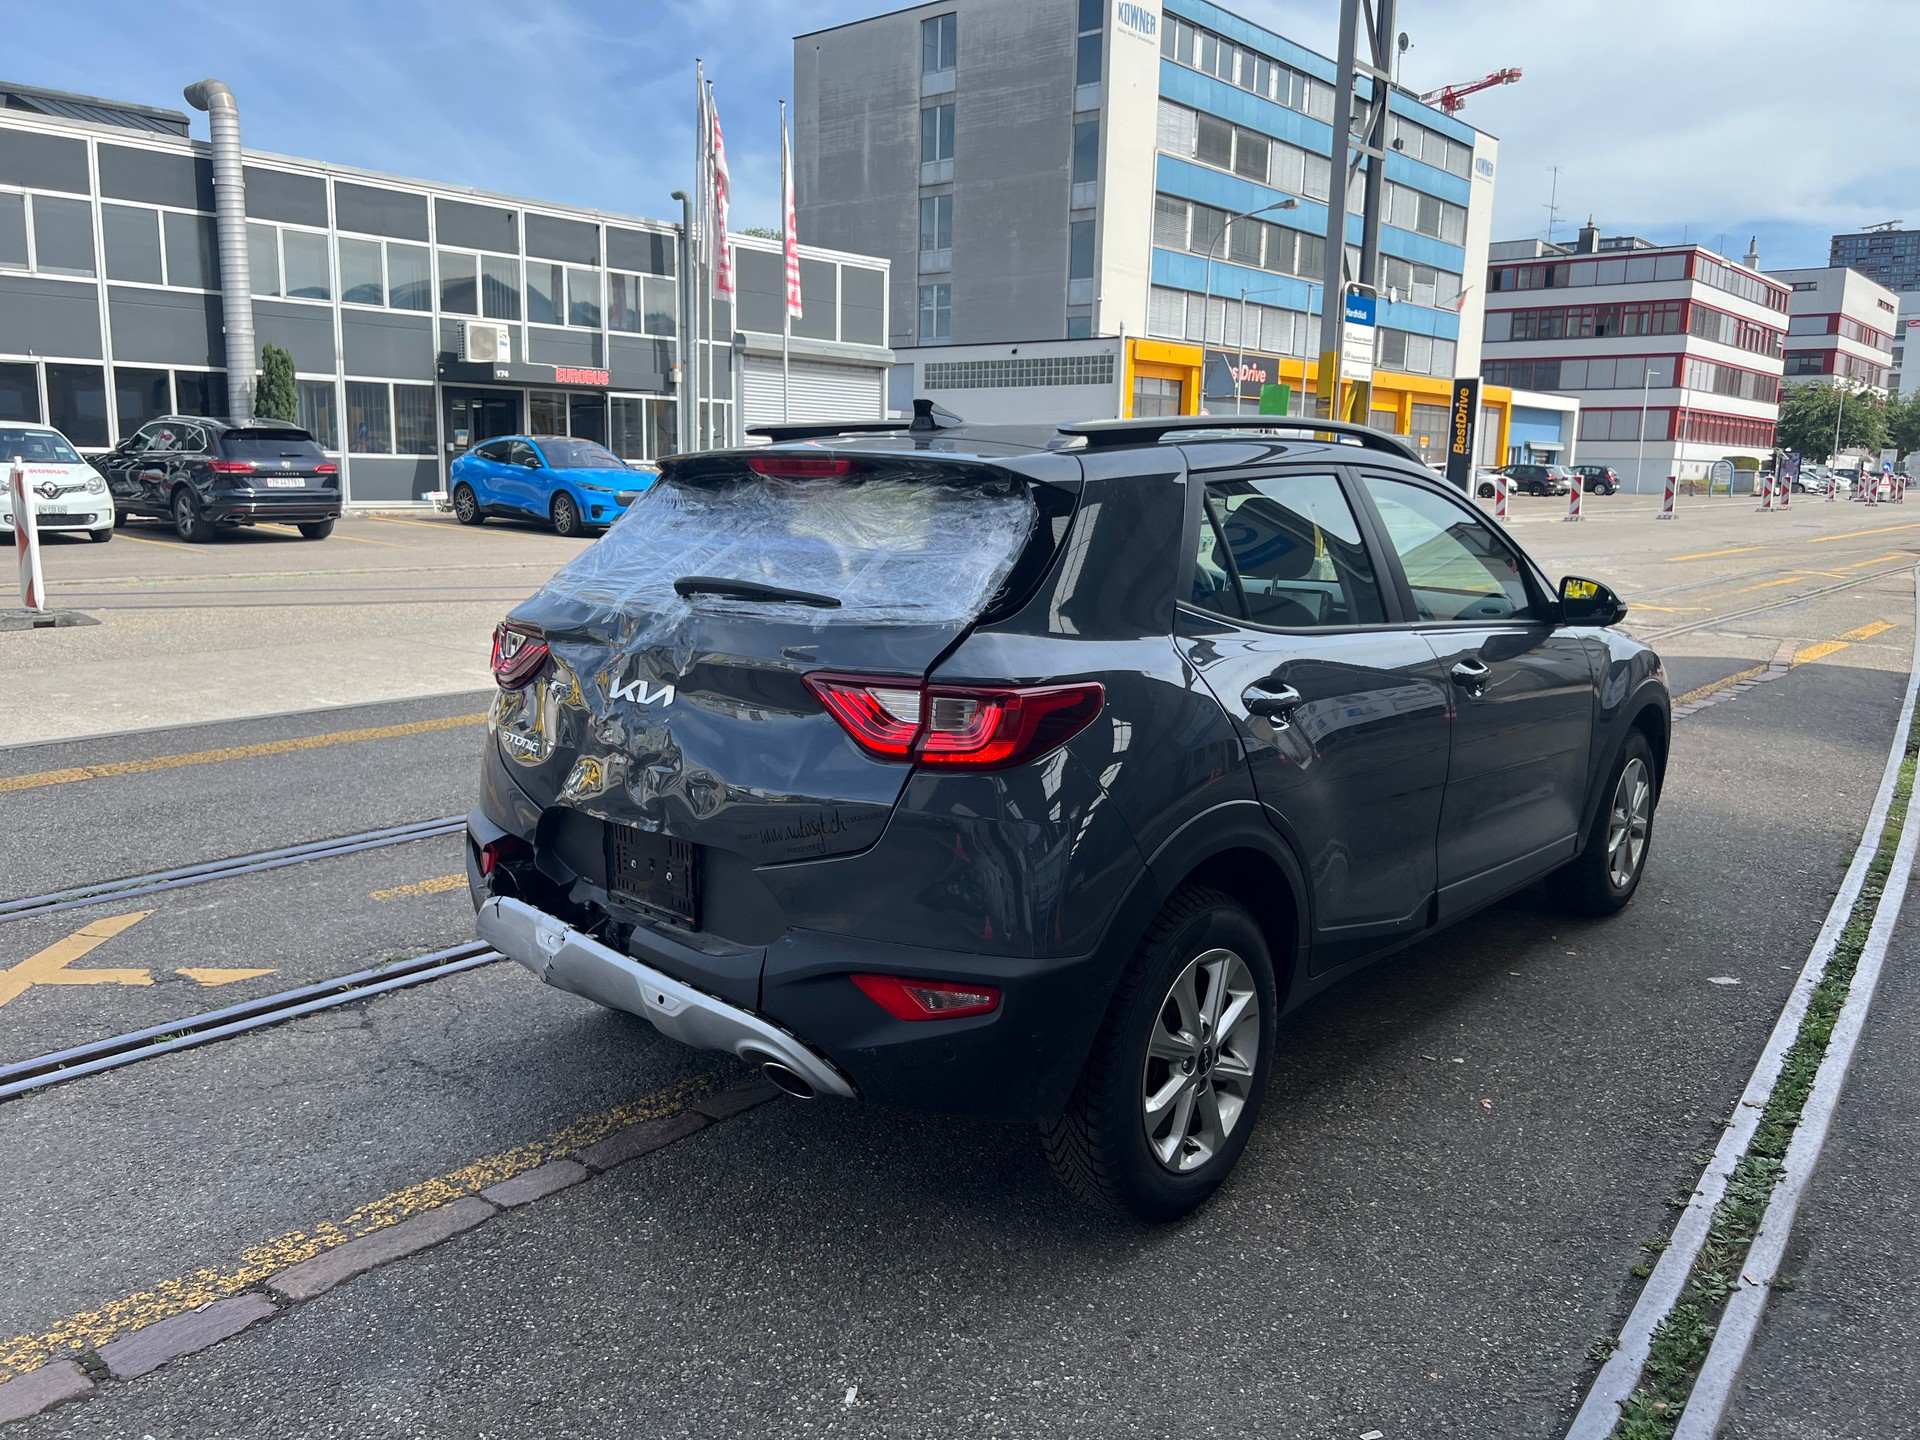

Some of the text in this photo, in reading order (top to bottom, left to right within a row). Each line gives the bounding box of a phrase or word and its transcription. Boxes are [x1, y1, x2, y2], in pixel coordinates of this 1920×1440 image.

[1118, 2, 1156, 35] KOWNER
[496, 370, 509, 378] 174
[556, 367, 609, 385] EUROBUS
[1453, 387, 1469, 454] BestDrive
[609, 677, 675, 708] KIA
[503, 731, 540, 752] STONIC
